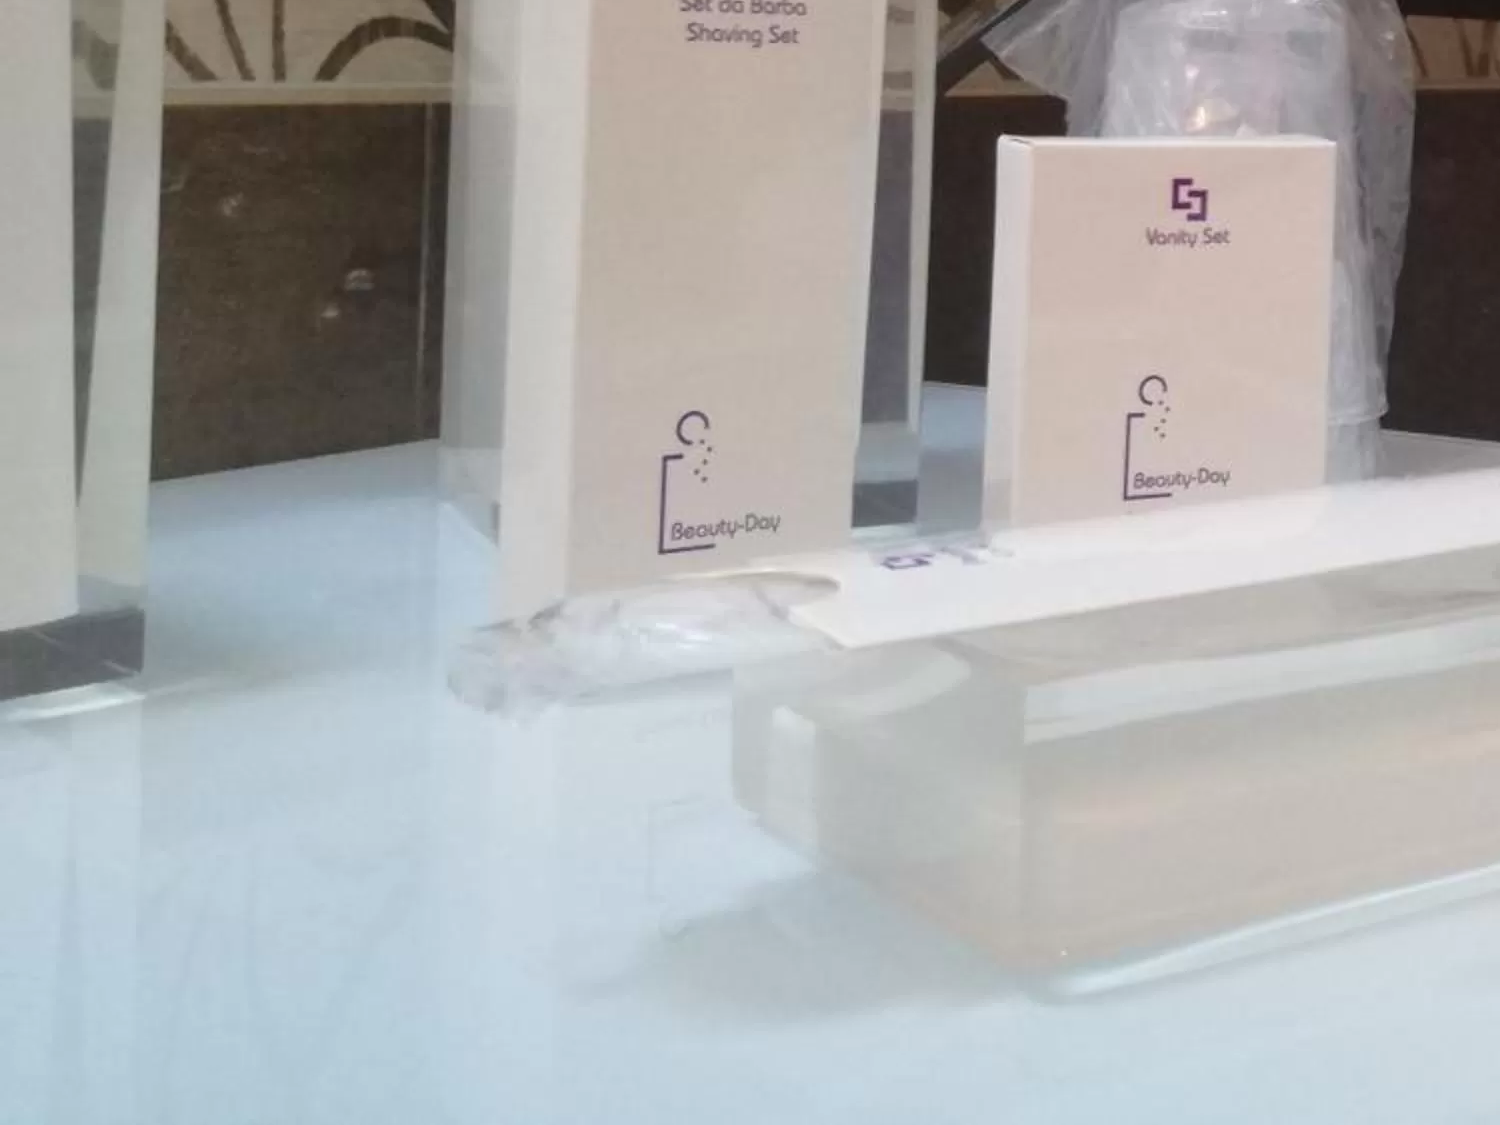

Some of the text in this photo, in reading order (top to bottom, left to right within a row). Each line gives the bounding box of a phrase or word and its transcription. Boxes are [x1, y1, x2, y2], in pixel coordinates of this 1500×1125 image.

[686, 22, 801, 48] Shaving Set
[1146, 227, 1231, 248] Vanity Set
[1132, 467, 1231, 490] Beauty-Day
[671, 512, 781, 541] Beauty-Day
